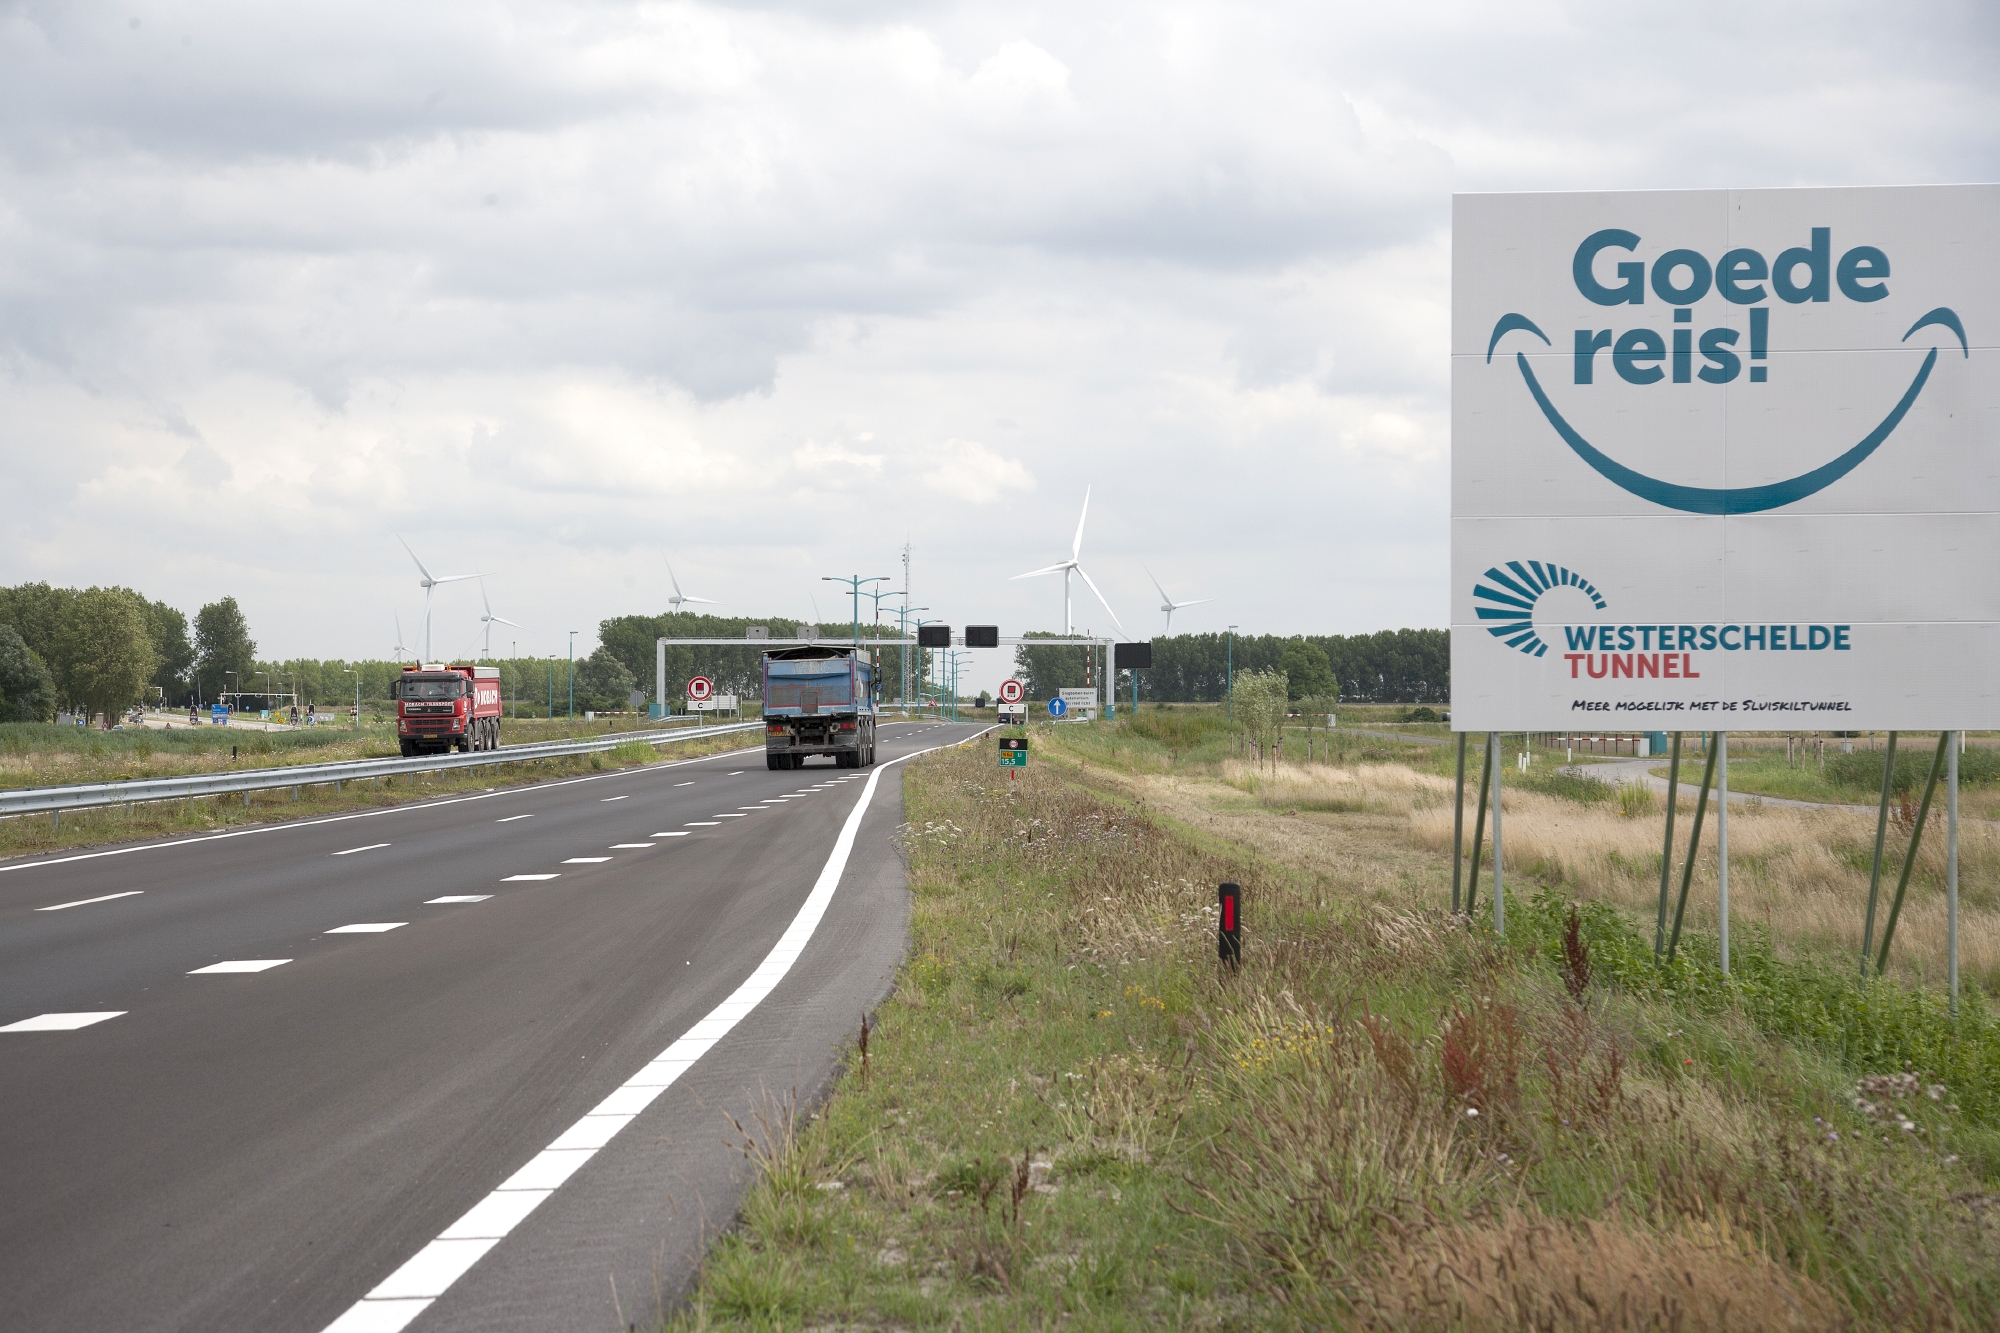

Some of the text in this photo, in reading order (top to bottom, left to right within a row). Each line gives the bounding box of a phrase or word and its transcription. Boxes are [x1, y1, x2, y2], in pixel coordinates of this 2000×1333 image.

[1573, 227, 1890, 306] Goede
[1573, 307, 1769, 385] reis!
[1565, 625, 1850, 650] WESTERSCHELDE
[1564, 654, 1700, 678] TUNNEL
